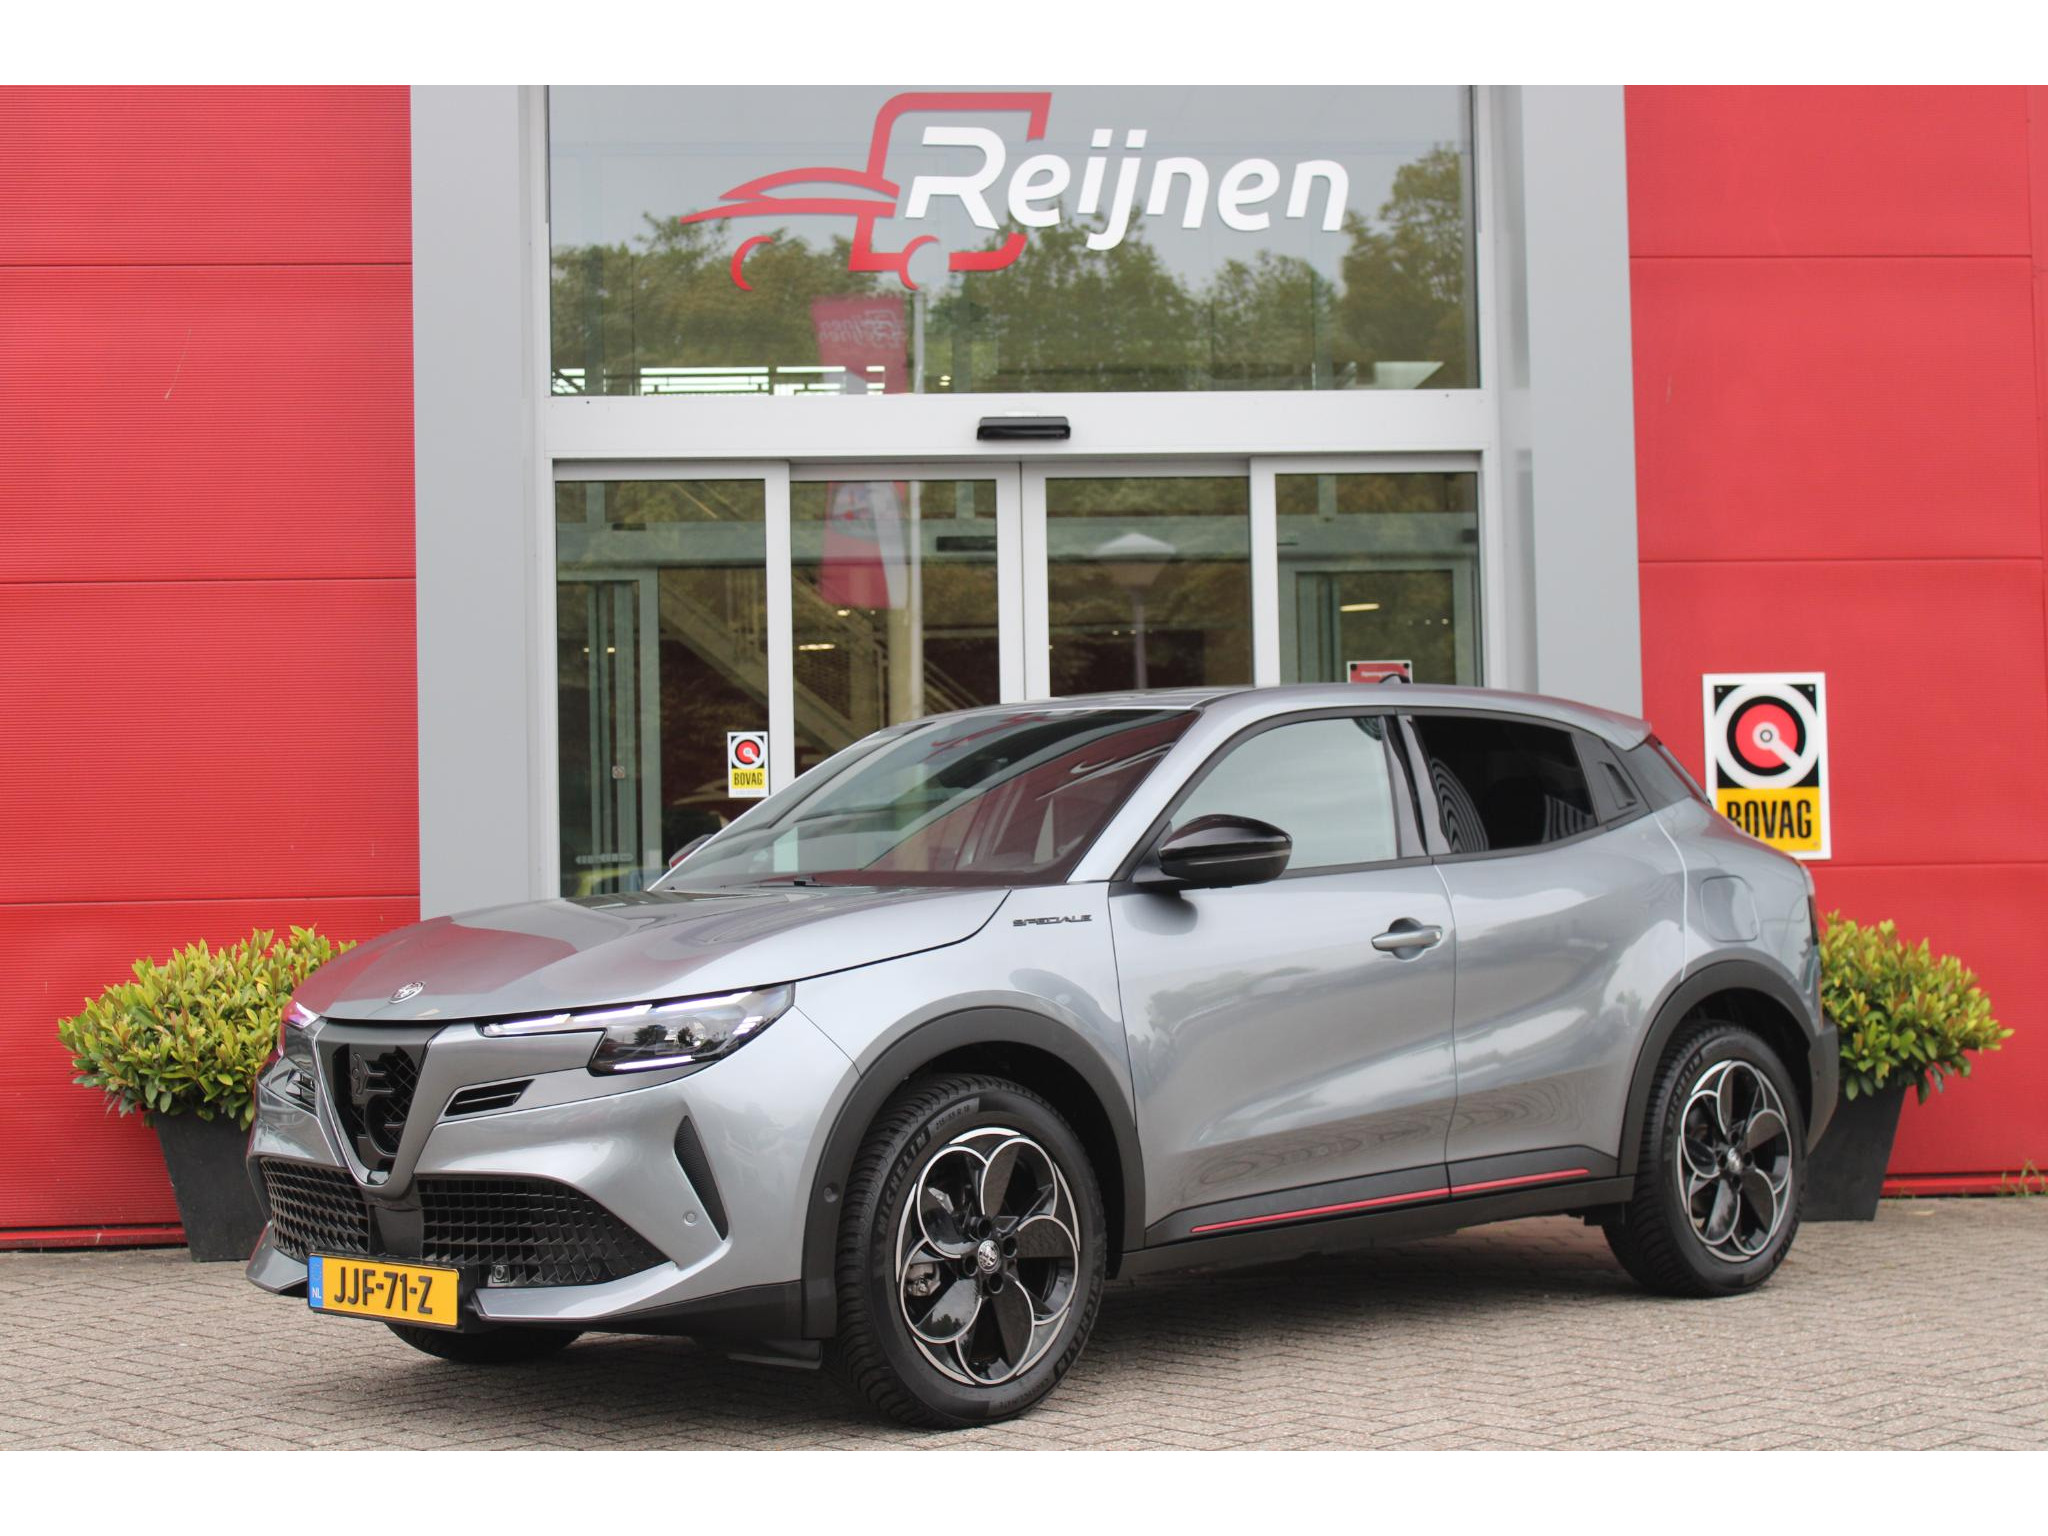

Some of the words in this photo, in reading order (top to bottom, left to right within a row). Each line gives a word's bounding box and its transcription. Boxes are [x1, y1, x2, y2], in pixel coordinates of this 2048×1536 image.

[905, 126, 1349, 251] Reijnen
[734, 772, 763, 786] BOVAG
[1726, 799, 1812, 839] BOVAG
[311, 1286, 322, 1300] NL
[334, 1266, 433, 1315] JJF-71-Z
